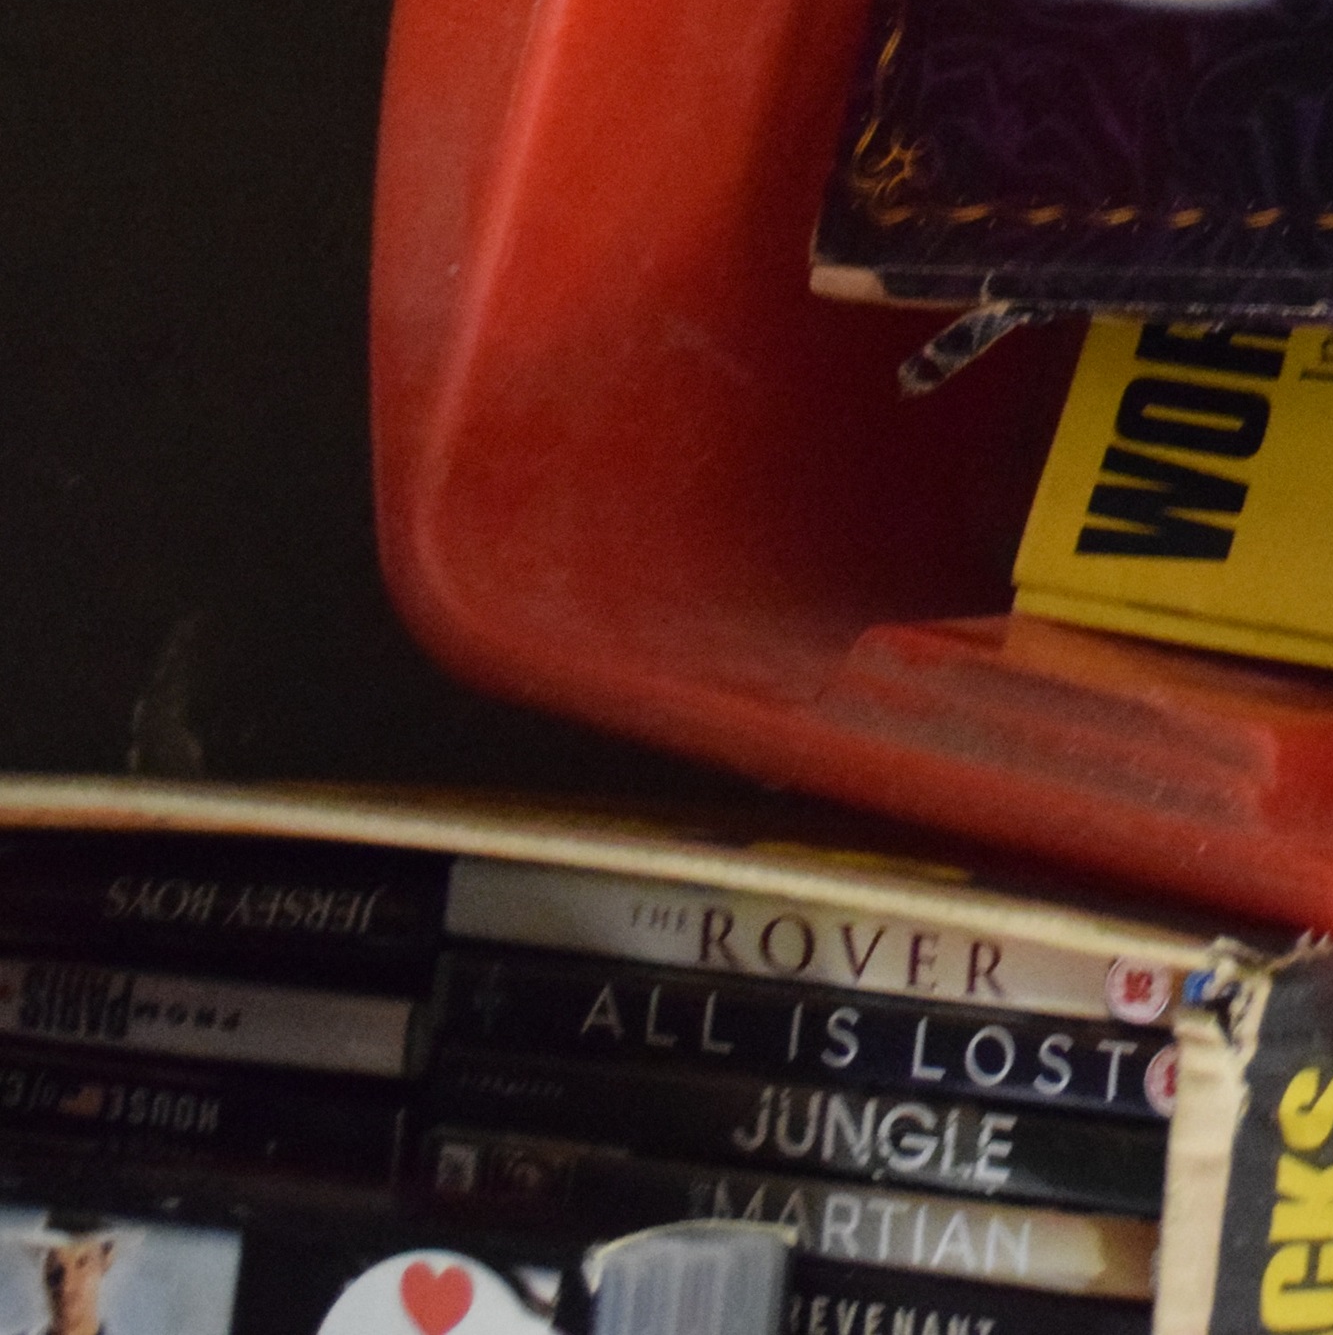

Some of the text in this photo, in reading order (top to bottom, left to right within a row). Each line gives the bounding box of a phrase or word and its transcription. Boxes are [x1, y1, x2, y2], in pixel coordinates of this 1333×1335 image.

[104, 875, 388, 935] JERSEY BOYS
[629, 903, 1007, 1001] THE ROVER
[132, 1000, 241, 1033] FROM
[581, 985, 734, 1054] ALL
[788, 1003, 861, 1067] IS
[911, 1017, 1138, 1104] LOST
[106, 1085, 220, 1133] HOUSE
[733, 1085, 1017, 1194] JUNGLE
[710, 1178, 1033, 1277] MARTIAN
